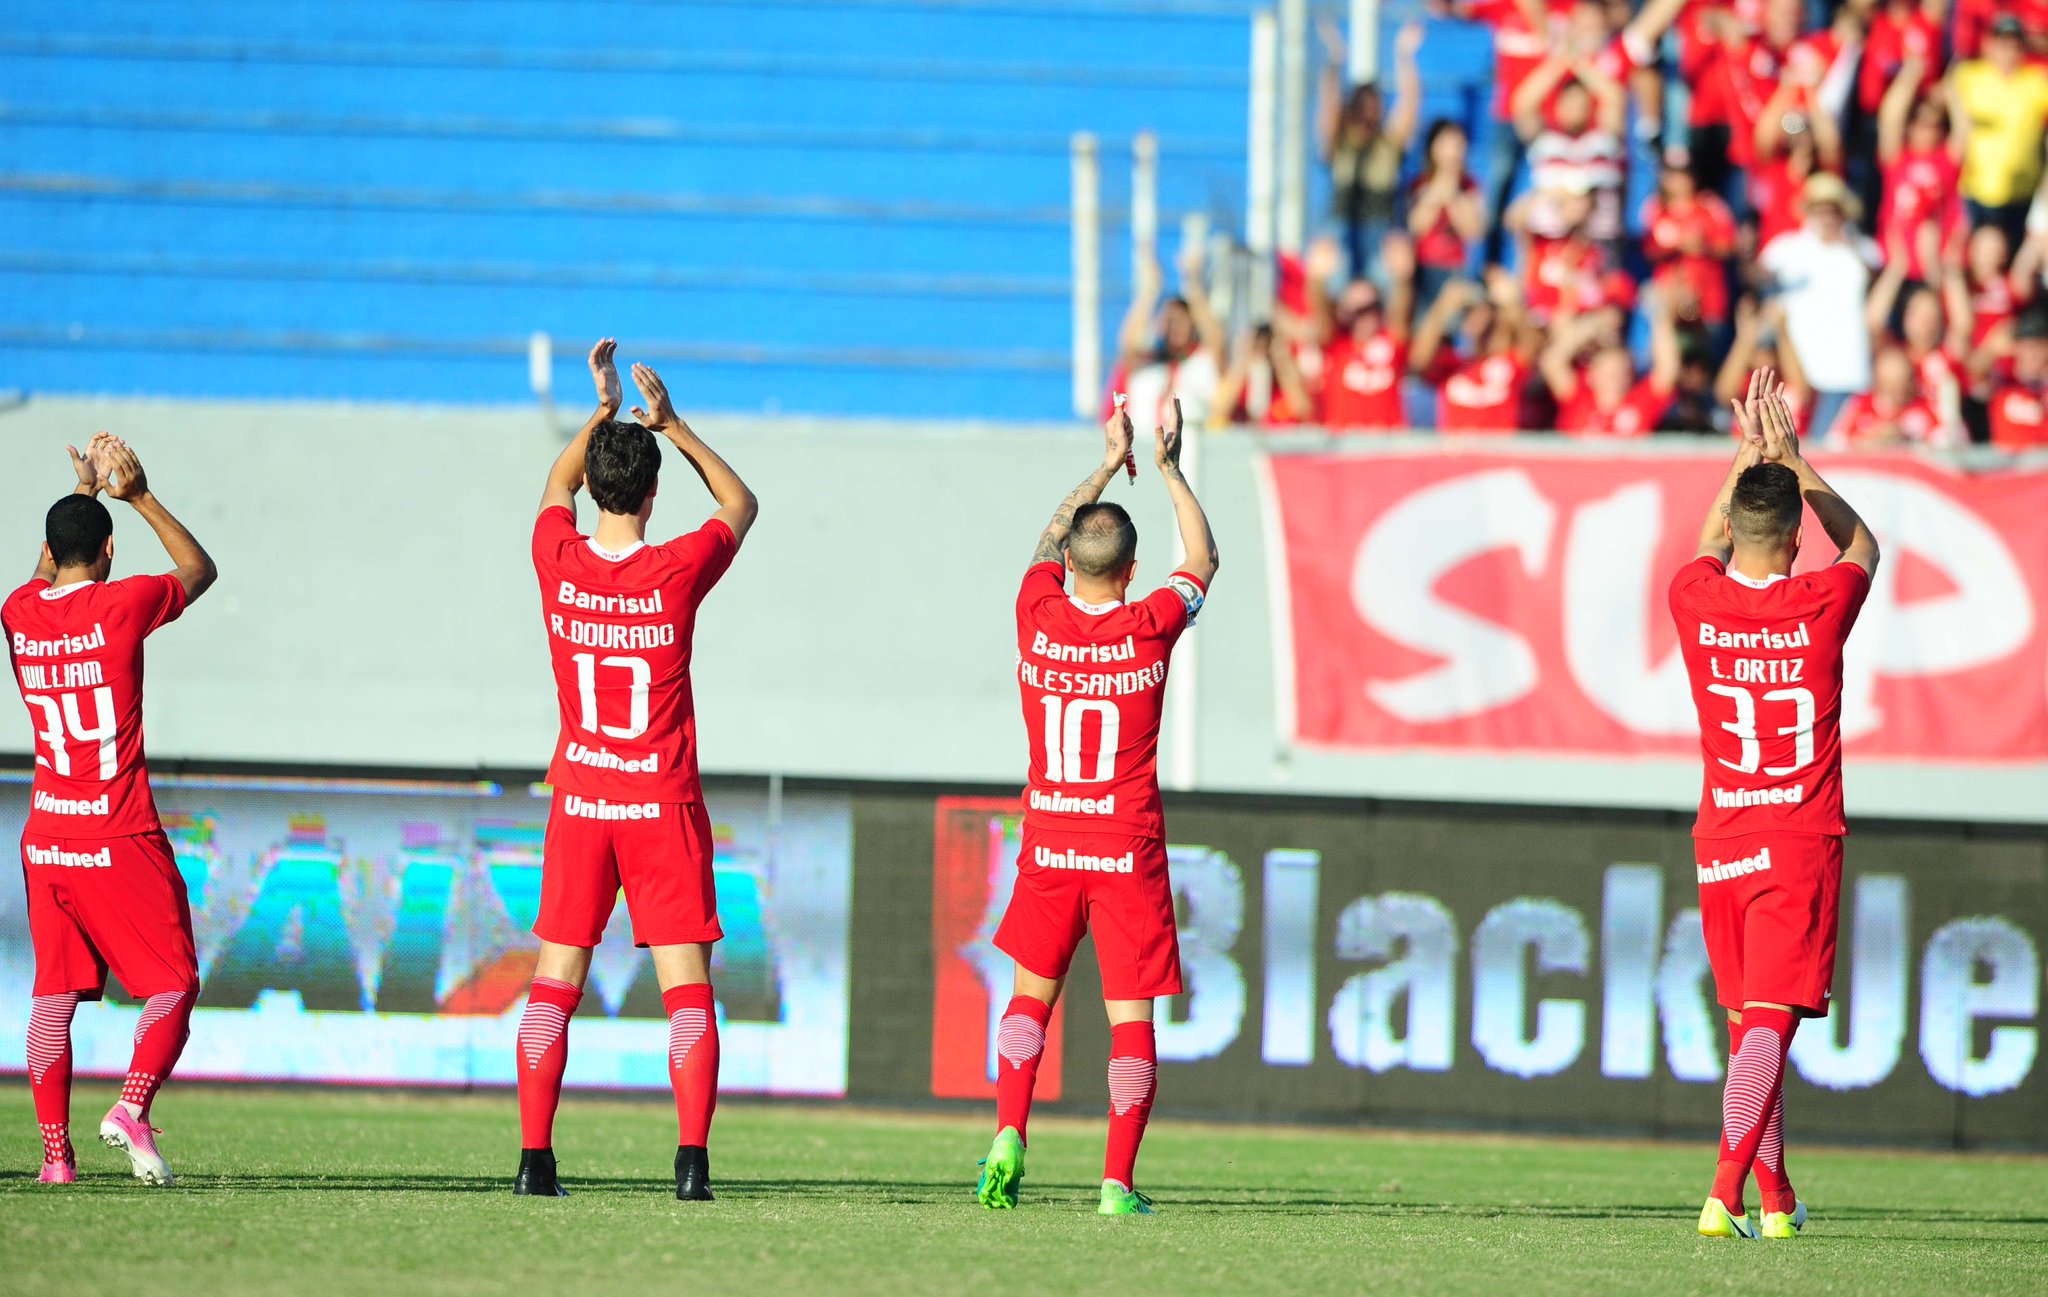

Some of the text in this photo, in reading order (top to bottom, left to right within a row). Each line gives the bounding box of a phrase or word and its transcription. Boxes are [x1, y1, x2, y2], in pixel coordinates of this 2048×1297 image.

[557, 580, 663, 614] Banrisul
[1350, 467, 2035, 739] SUP
[13, 622, 106, 657] Banrisul
[550, 612, 674, 650] R.DOURADO
[1031, 630, 1136, 663] Banrisul
[1698, 622, 1810, 651] Banrisul
[20, 660, 104, 690] WILLIAM
[571, 653, 651, 740] 13
[24, 686, 118, 781] 34
[1039, 694, 1120, 783] 10
[1706, 682, 1815, 777] 33
[565, 741, 659, 773] Unimed
[33, 789, 109, 816] Unimed
[1029, 789, 1115, 815] Unimed
[1711, 784, 1804, 808] Unimed
[26, 844, 112, 868] Unimed
[1034, 845, 1134, 874] Unimed
[1152, 845, 1724, 1083] Black
